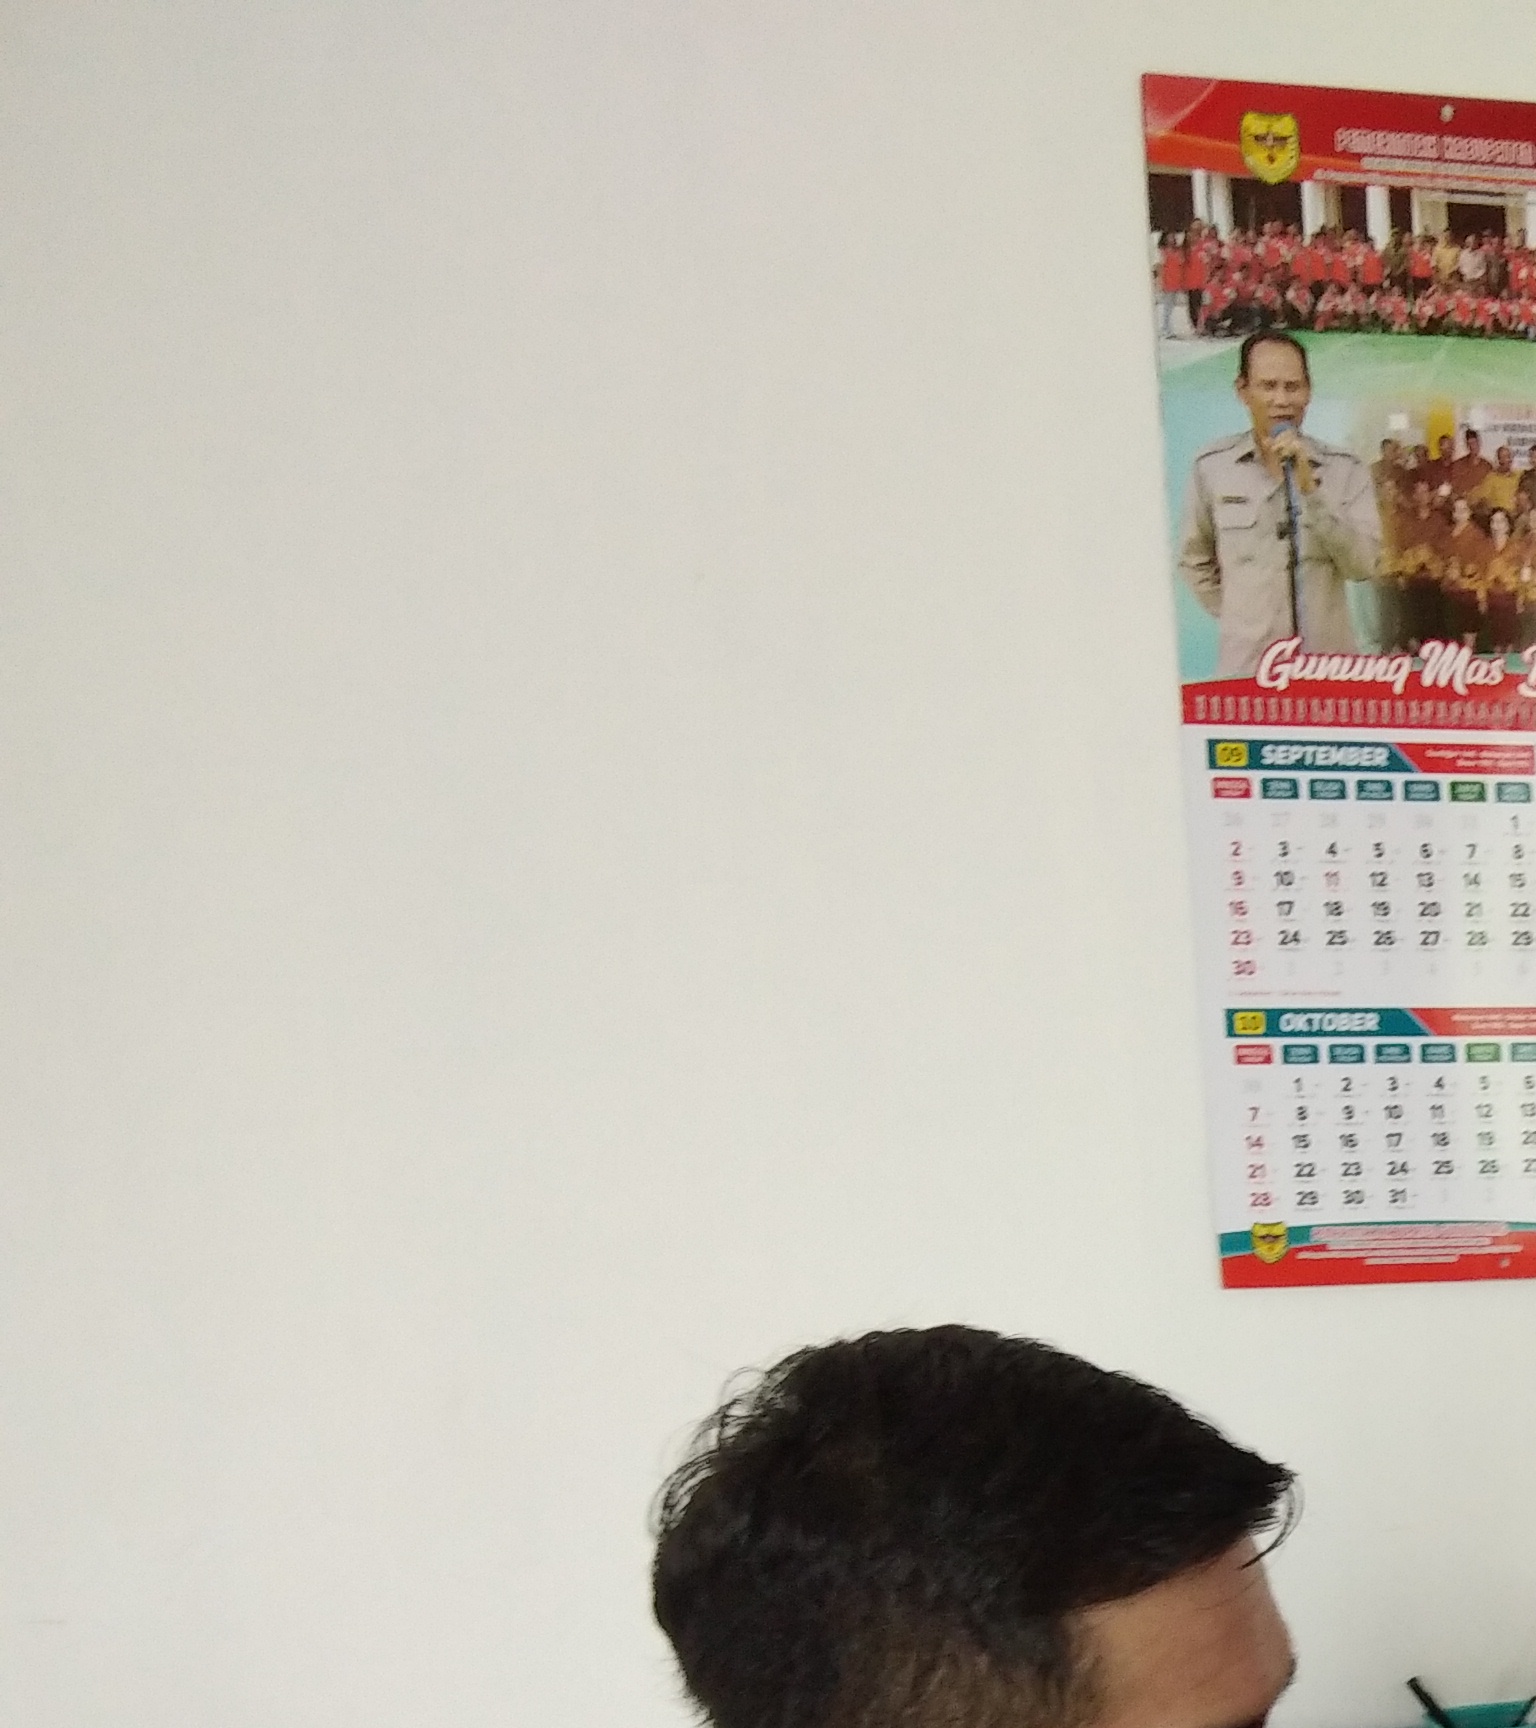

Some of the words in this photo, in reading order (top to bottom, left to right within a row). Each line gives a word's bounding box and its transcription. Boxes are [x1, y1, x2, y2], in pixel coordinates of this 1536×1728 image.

[1255, 637, 1411, 695] Gunung
[1418, 639, 1505, 695] Mas
[1261, 744, 1390, 767] SEPTEMBER
[1230, 841, 1242, 857] 2
[1278, 841, 1289, 857] 3
[1325, 841, 1339, 857] 4
[1465, 843, 1478, 859] 7
[1369, 871, 1388, 887] 12
[1416, 871, 1435, 888] 13
[1276, 901, 1295, 916] 17
[1418, 901, 1441, 917] 20
[1509, 902, 1530, 917] 22
[1231, 930, 1252, 945] 23
[1278, 929, 1301, 945] 24
[1325, 930, 1348, 945] 25
[1419, 930, 1441, 946] 27
[1278, 1013, 1381, 1032] OKTOBER
[1293, 1077, 1302, 1092] 1
[1341, 1077, 1352, 1092] 2
[1386, 1076, 1399, 1091] 3
[1433, 1076, 1445, 1090] 4
[1248, 1106, 1260, 1121] 7
[1474, 1103, 1493, 1118] 12
[1385, 1132, 1402, 1147] 17
[1294, 1162, 1317, 1177] 22
[1341, 1161, 1363, 1177] 23
[1387, 1161, 1409, 1176] 24
[1432, 1160, 1454, 1175] 25
[1388, 1188, 1408, 1204] 31
